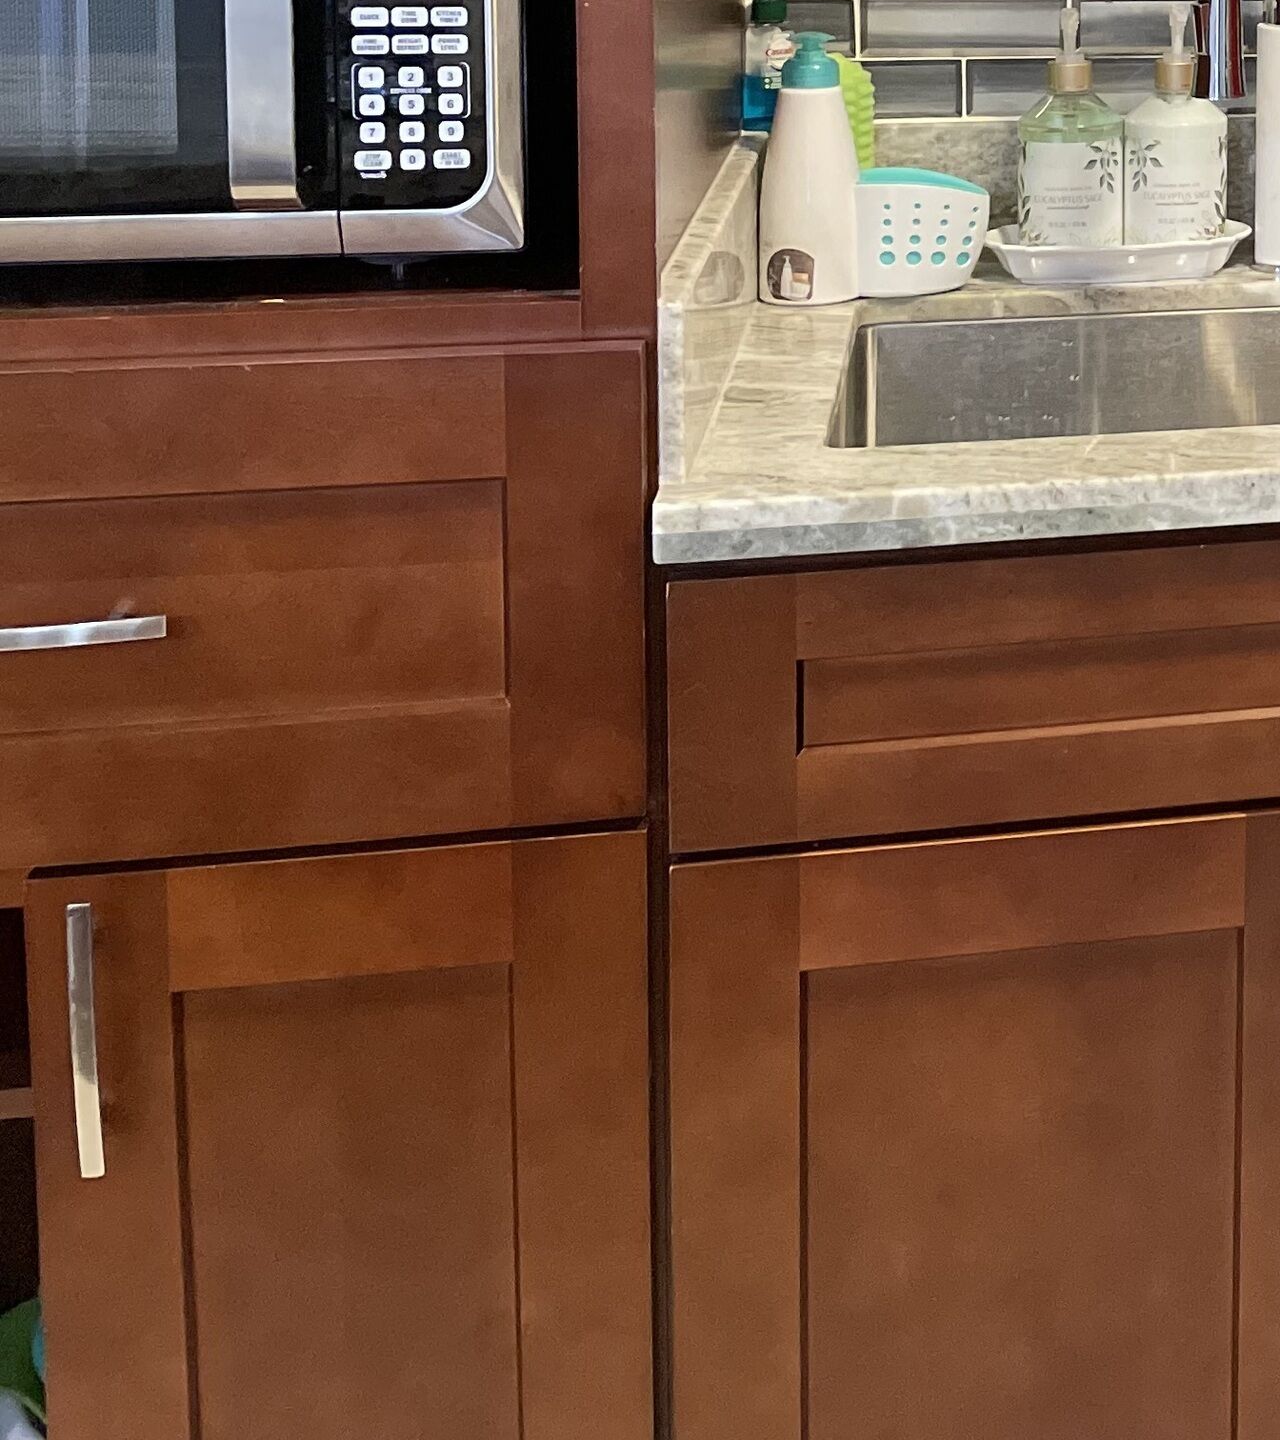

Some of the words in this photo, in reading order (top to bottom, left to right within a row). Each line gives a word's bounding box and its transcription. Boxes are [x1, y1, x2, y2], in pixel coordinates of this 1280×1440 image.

[368, 73, 374, 81] 1
[407, 73, 414, 81] 2
[446, 72, 453, 81] 3
[368, 101, 375, 110] 4
[407, 100, 415, 109] 5
[446, 100, 454, 109] 6
[369, 128, 375, 137] 7
[408, 127, 415, 136] 8
[447, 127, 455, 136] 9
[408, 155, 416, 164] 0
